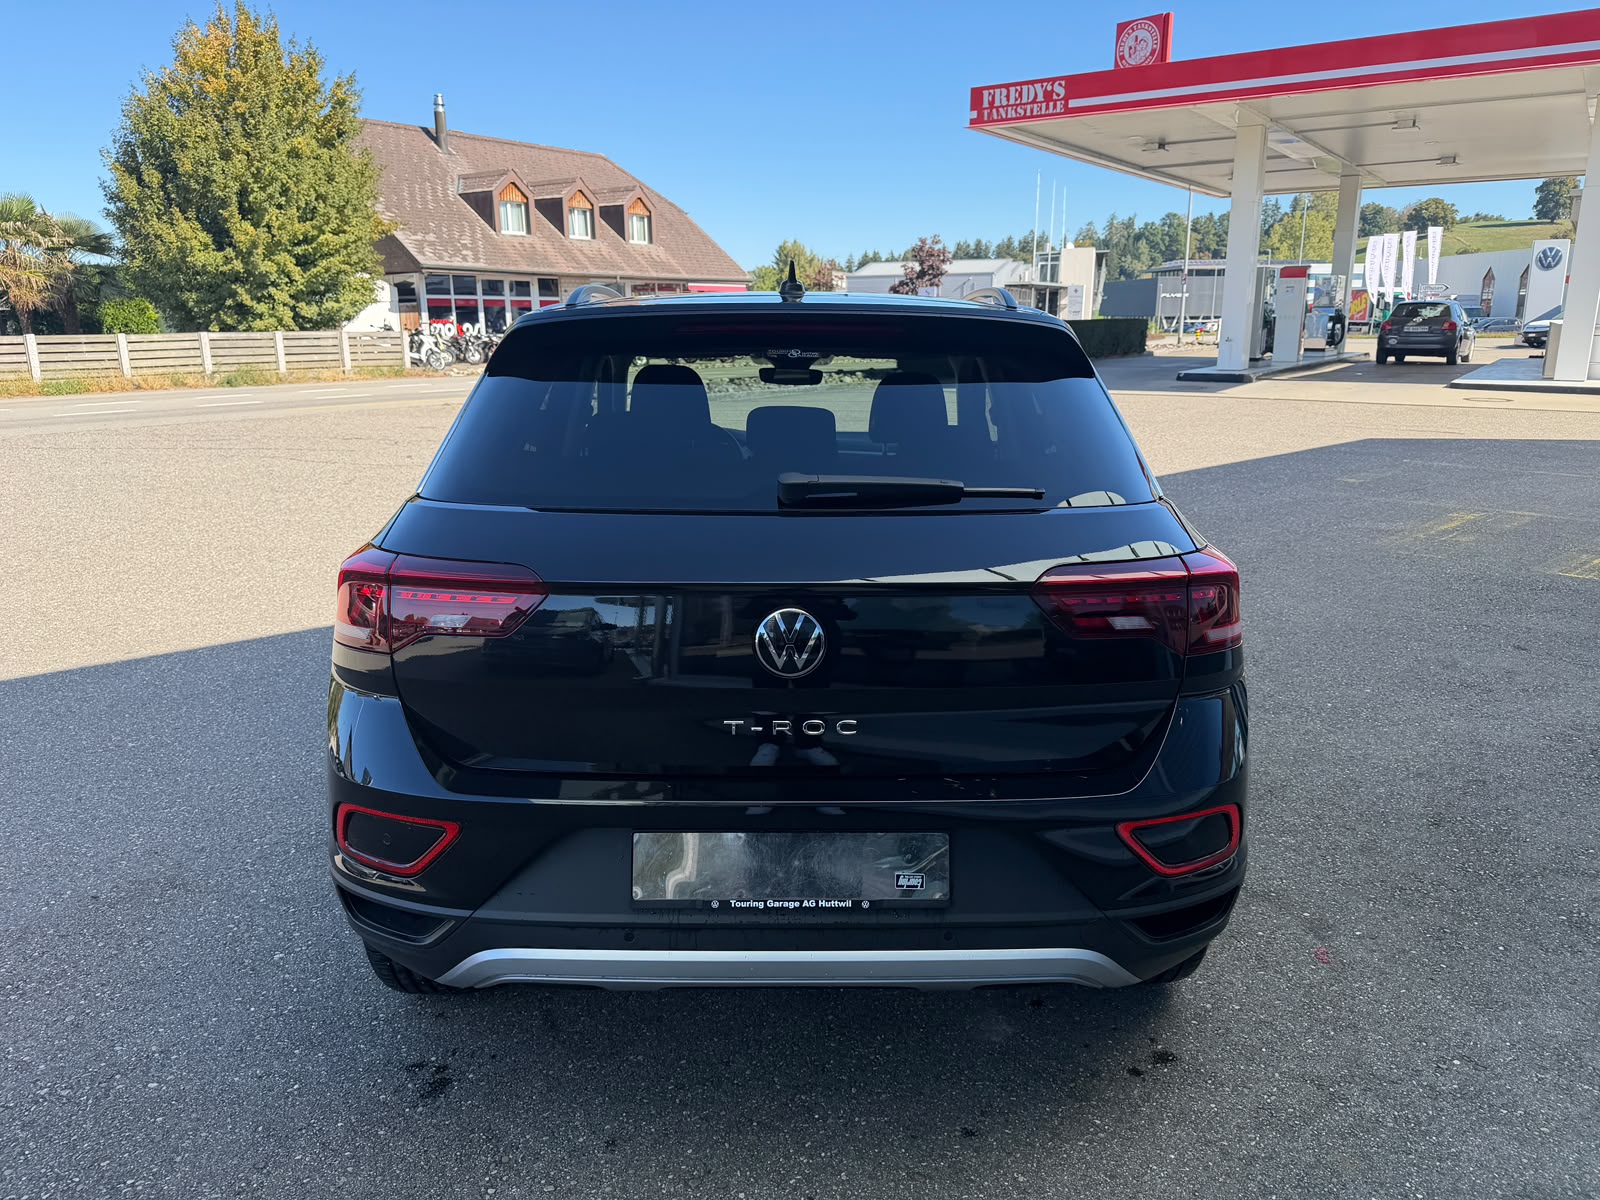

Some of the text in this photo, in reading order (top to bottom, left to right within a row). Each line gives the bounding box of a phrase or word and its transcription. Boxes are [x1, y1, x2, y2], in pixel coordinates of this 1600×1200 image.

[982, 80, 1066, 108] FREDY'S
[982, 100, 1065, 121] TANKSTELLE
[723, 719, 857, 735] T-ROC
[729, 900, 765, 909] Touring
[766, 899, 800, 909] Garage
[818, 899, 852, 908] Huttwil
